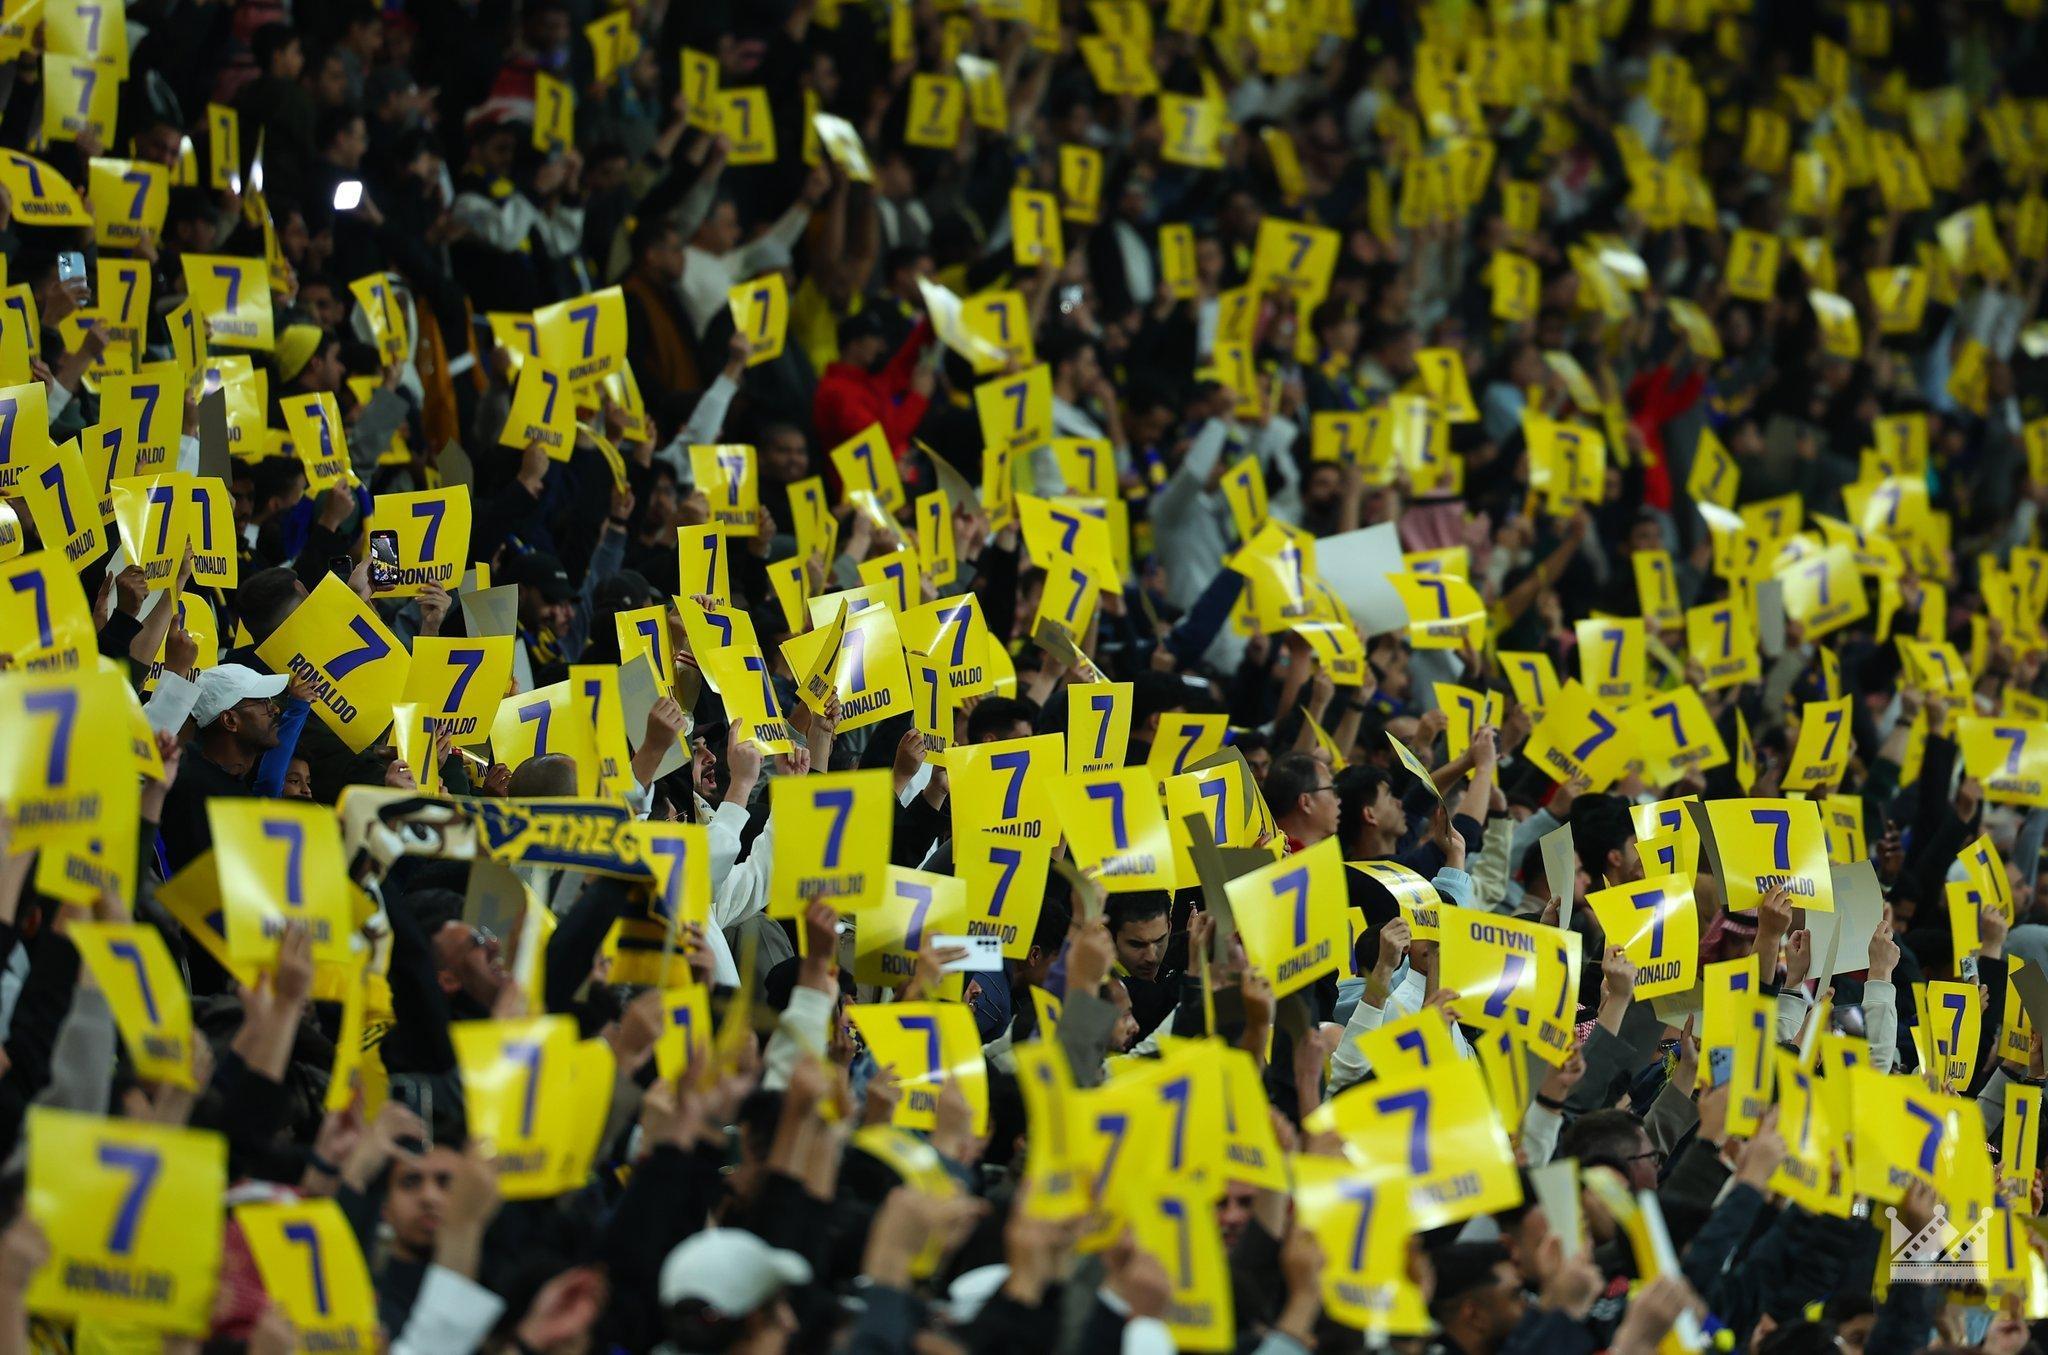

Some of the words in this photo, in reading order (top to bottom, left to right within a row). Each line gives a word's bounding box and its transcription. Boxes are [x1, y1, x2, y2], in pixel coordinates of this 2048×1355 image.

[77, 6, 102, 52] 7
[72, 68, 96, 114] 7
[10, 156, 44, 198] 7
[123, 171, 151, 220] 7
[119, 270, 137, 322] 7
[214, 265, 241, 315] 7
[754, 289, 771, 337] 7
[7, 296, 33, 347] 7
[514, 322, 538, 357] 7
[569, 305, 599, 358] 7
[986, 302, 1009, 340] 7
[131, 384, 160, 443] 7
[542, 371, 558, 424] 7
[1004, 382, 1028, 430] 7
[304, 404, 334, 457] 7
[102, 429, 122, 494] 7
[718, 455, 744, 506] 7
[853, 443, 878, 491] 7
[1078, 447, 1096, 489] 7
[41, 463, 76, 537] 7
[146, 485, 173, 555] 7
[192, 488, 212, 551] 7
[65, 529, 95, 562] ONALDO
[412, 500, 445, 562] 7
[1051, 510, 1080, 553] 7
[144, 559, 173, 581] RONALDO
[194, 555, 227, 575] RONALDO
[398, 564, 453, 584] RONALDO
[703, 534, 718, 595] 7
[884, 563, 906, 611] 7
[1805, 561, 1829, 605] 7
[10, 570, 53, 649] 7
[1066, 567, 1087, 622] 7
[1419, 580, 1449, 618] 7
[323, 614, 391, 682] 7
[637, 619, 665, 680] 7
[843, 628, 865, 694] 7
[937, 604, 972, 667] 7
[1603, 630, 1624, 678] 7
[1712, 611, 1731, 657] 7
[443, 649, 484, 712] 7
[923, 667, 938, 729] 7
[1519, 661, 1544, 705] 7
[24, 691, 77, 787] 7
[519, 700, 551, 756] 7
[754, 723, 788, 743] RONA
[1092, 695, 1113, 759] 7
[1173, 725, 1204, 775] 7
[1574, 710, 1616, 761] 7
[1652, 702, 1687, 748] 7
[1821, 710, 1842, 761] 7
[1995, 728, 2026, 774] 7
[990, 750, 1030, 820] 7
[1199, 778, 1228, 845] 7
[815, 789, 854, 869] 7
[1086, 783, 1127, 849] 7
[1751, 810, 1790, 870] 7
[263, 821, 303, 907] 7
[652, 838, 685, 918] 7
[989, 847, 1021, 917] 7
[896, 881, 932, 952] 7
[1272, 867, 1309, 948] 7
[1633, 889, 1664, 959] 7
[110, 942, 160, 1026] 7
[1483, 955, 1525, 1017] 7
[899, 1017, 942, 1083] 7
[1943, 994, 1966, 1056] 7
[1161, 1077, 1190, 1171] 7
[1376, 1090, 1430, 1175] 7
[1906, 1099, 1943, 1173] 7
[1097, 1116, 1126, 1196] 7
[99, 1142, 160, 1253] 7
[285, 1222, 327, 1316] 7
